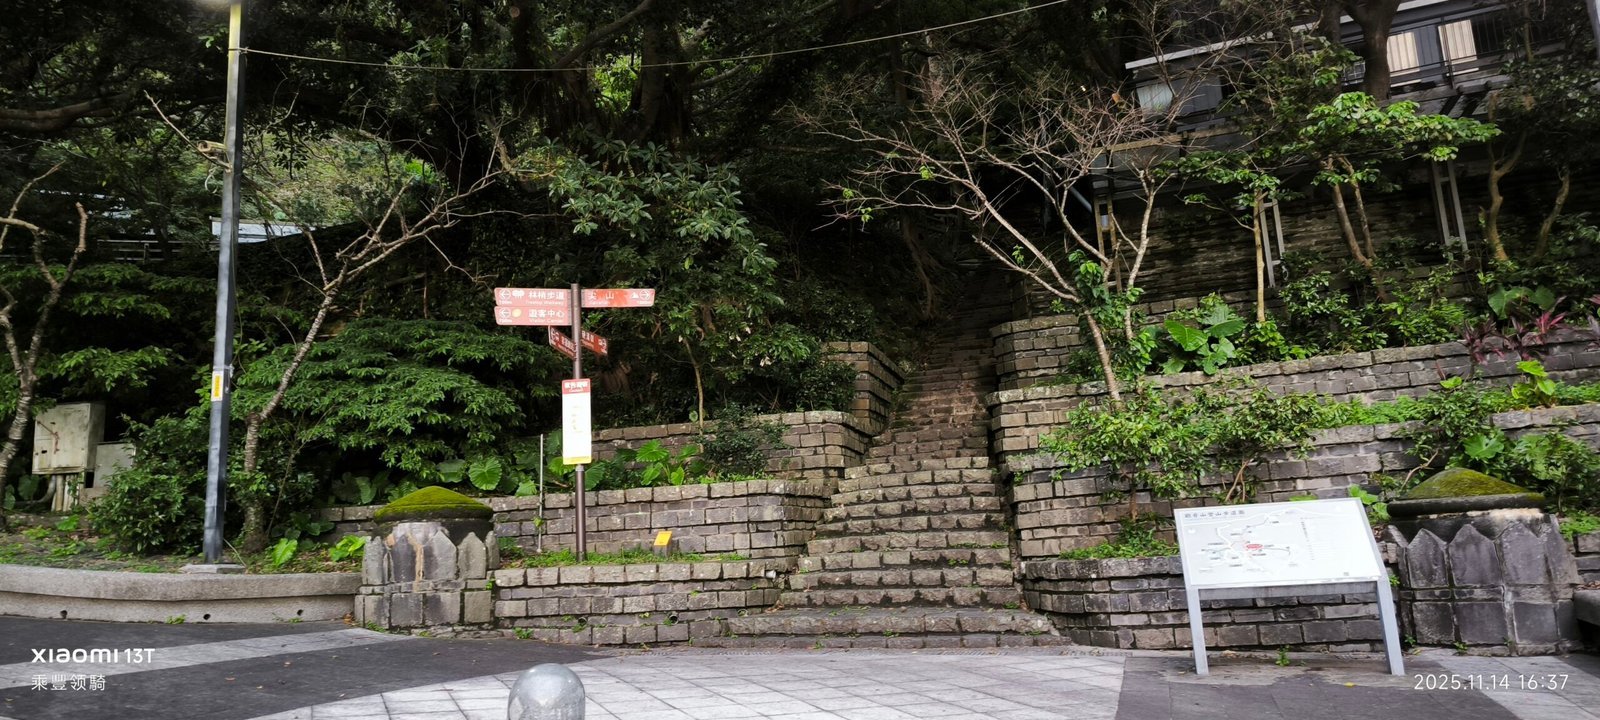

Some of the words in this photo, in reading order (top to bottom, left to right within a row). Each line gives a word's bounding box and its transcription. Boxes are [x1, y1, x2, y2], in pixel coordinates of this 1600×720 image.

[528, 290, 565, 300] 林梢步道
[528, 309, 565, 318] 遊客中心
